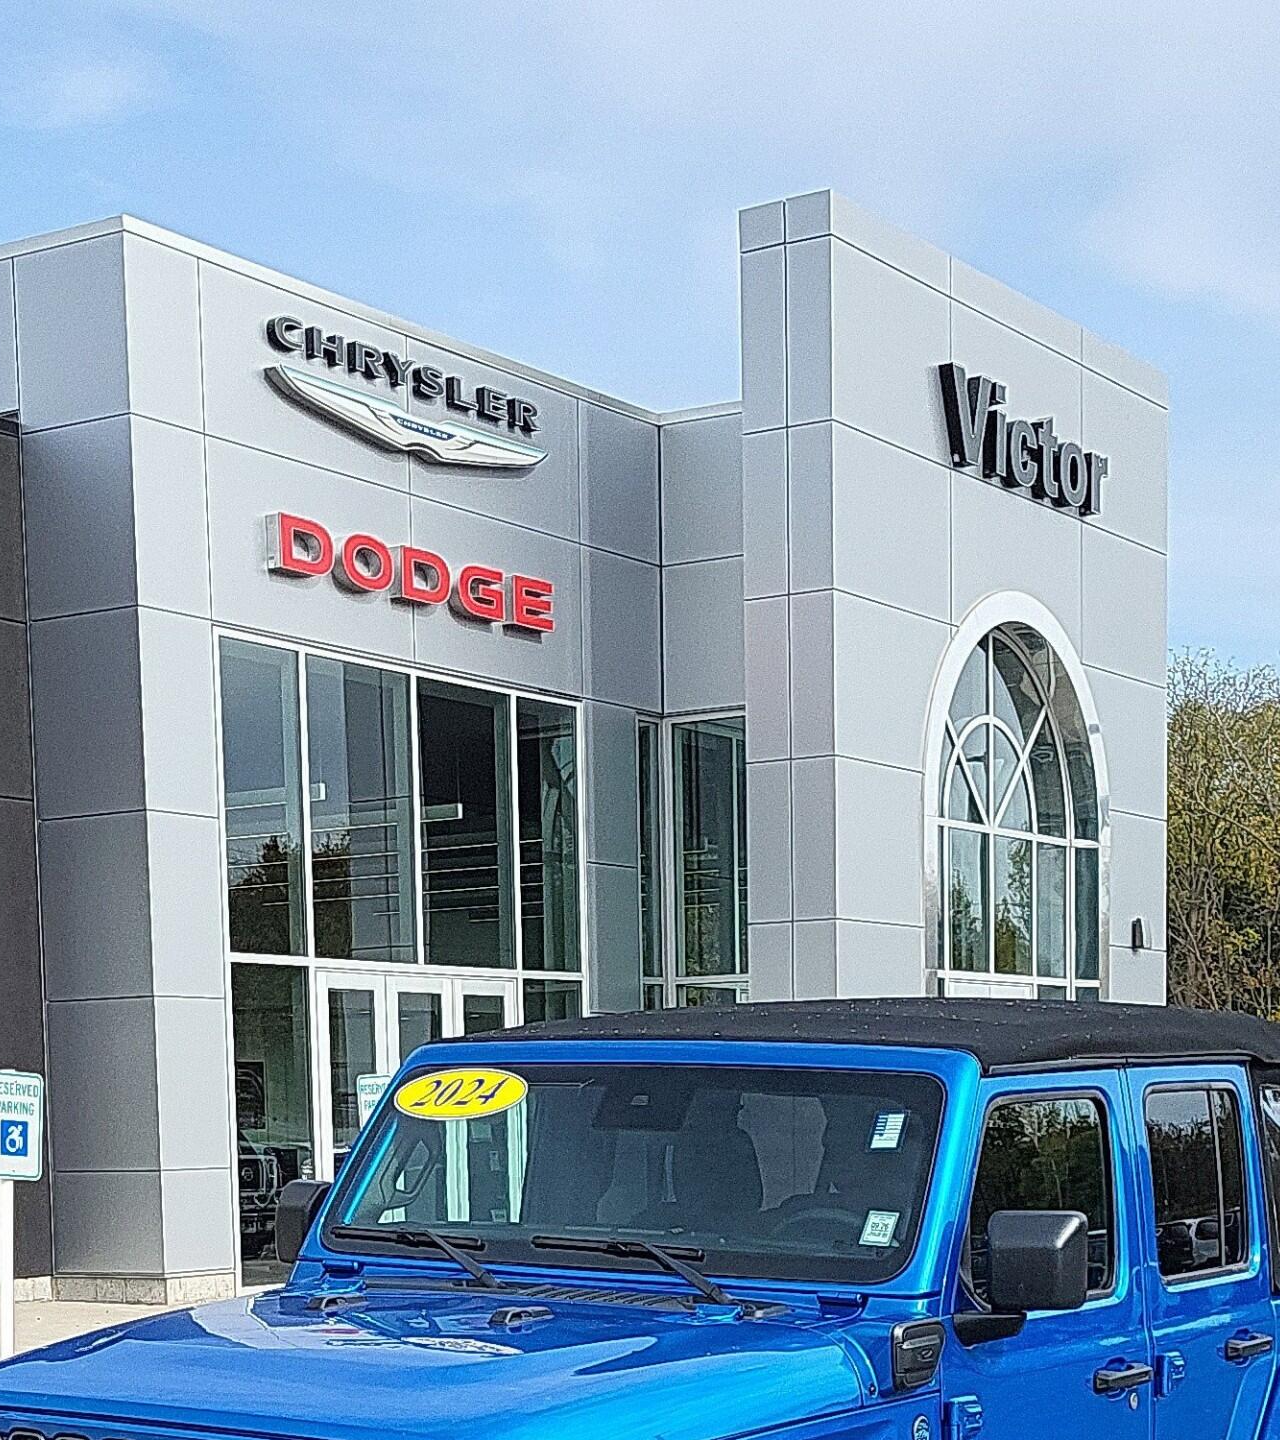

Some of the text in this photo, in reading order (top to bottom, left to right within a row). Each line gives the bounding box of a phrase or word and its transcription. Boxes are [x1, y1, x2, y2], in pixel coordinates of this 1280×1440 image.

[267, 316, 541, 431] CHRYSLER
[939, 362, 1108, 516] Victor
[270, 512, 555, 634] DODGE
[410, 1076, 510, 1107] 2024
